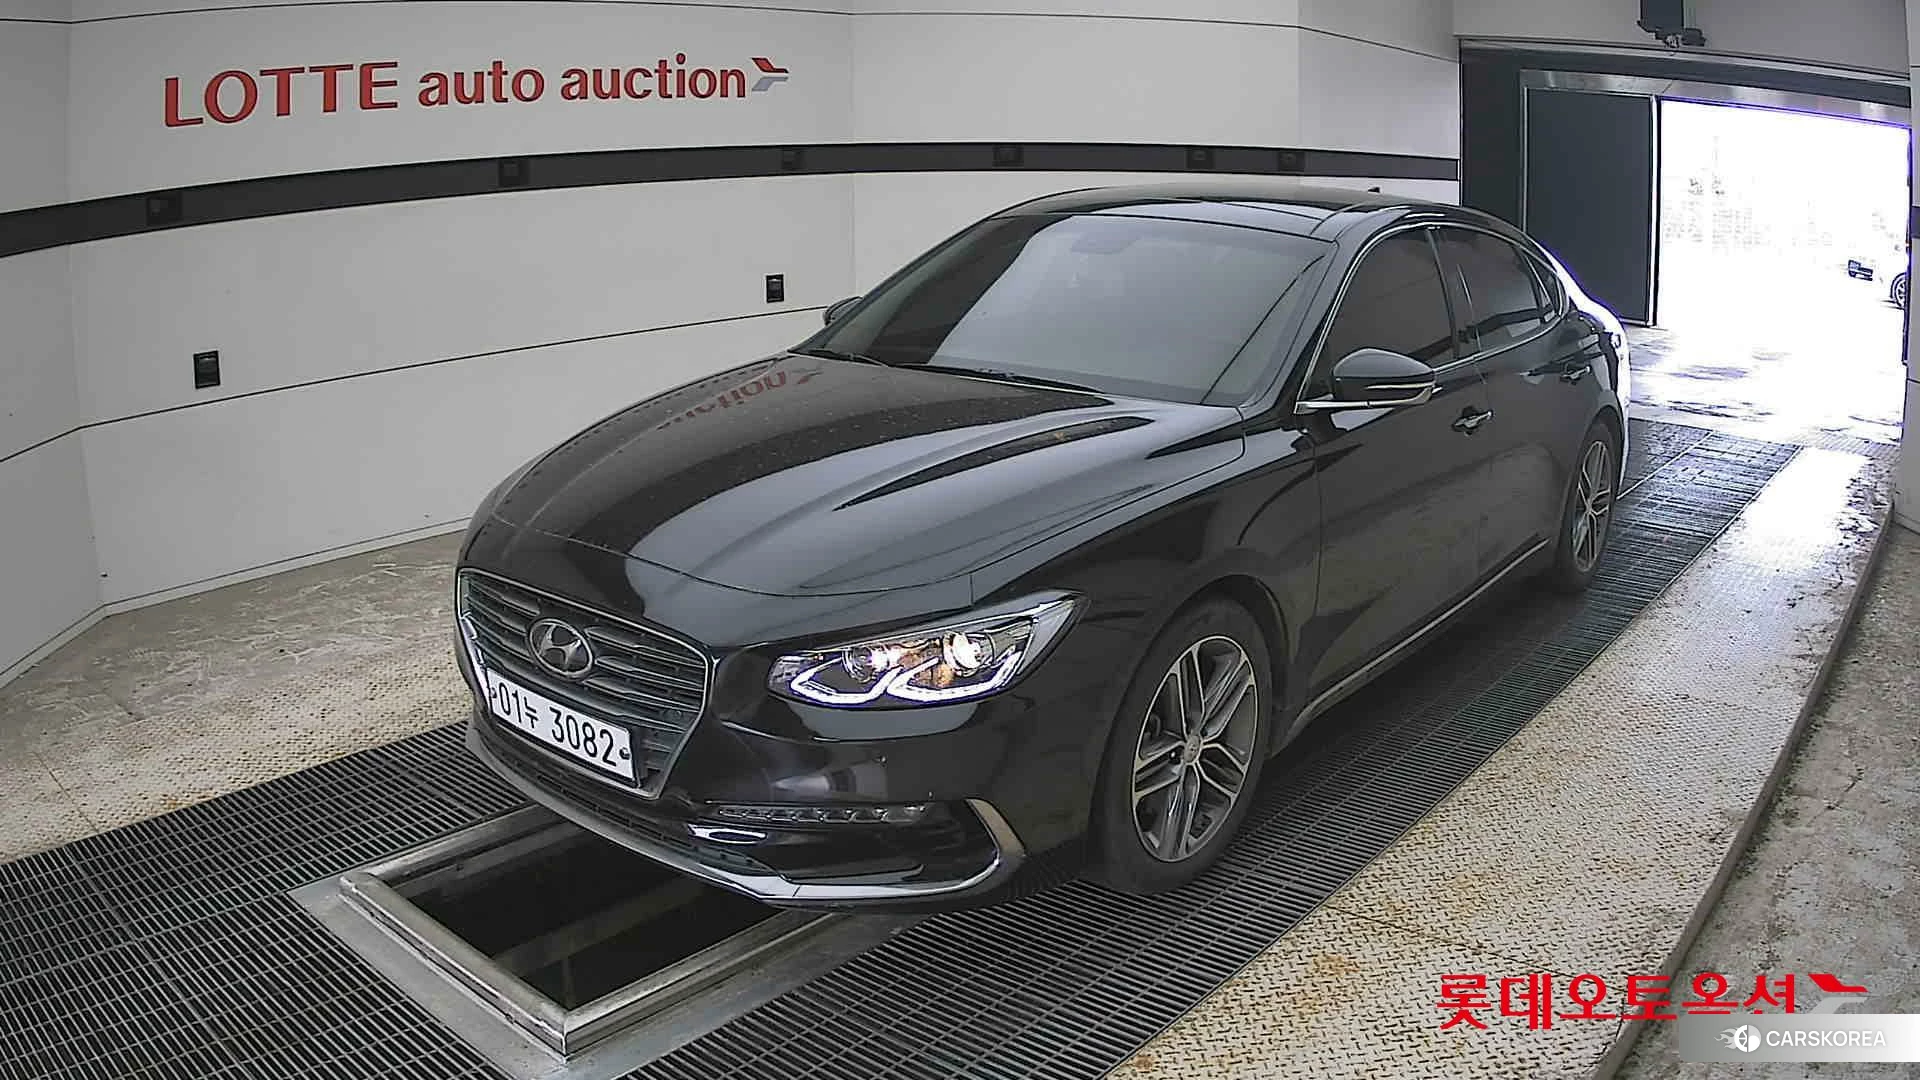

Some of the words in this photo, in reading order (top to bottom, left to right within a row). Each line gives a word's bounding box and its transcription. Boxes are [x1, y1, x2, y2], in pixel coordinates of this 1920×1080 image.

[163, 62, 398, 128] LOTTE
[417, 60, 546, 107] auto
[560, 53, 748, 101] auction
[498, 682, 539, 729] 01누
[549, 705, 617, 767] 3082
